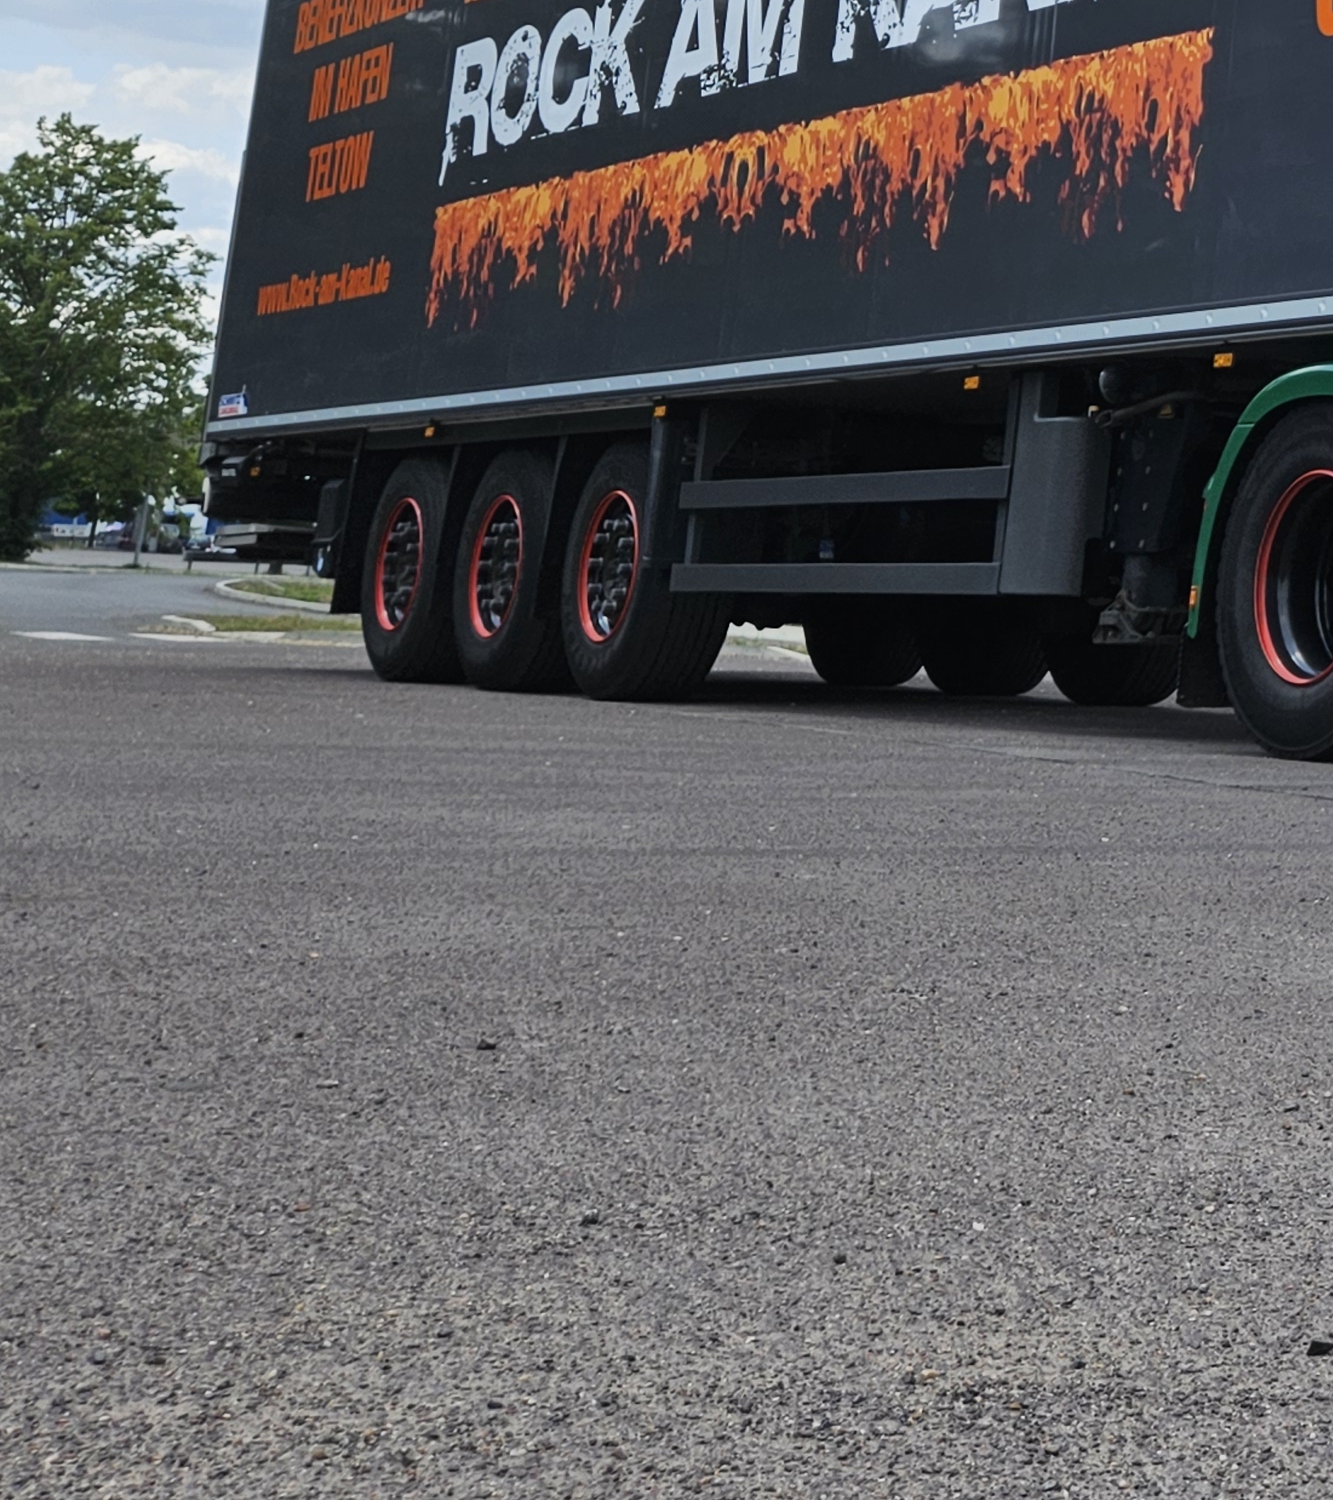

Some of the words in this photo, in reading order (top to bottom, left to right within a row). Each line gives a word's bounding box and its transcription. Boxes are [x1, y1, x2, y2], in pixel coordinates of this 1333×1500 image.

[308, 62, 335, 123] IM
[334, 41, 394, 115] HAFEN
[305, 129, 375, 203] TELTOW
